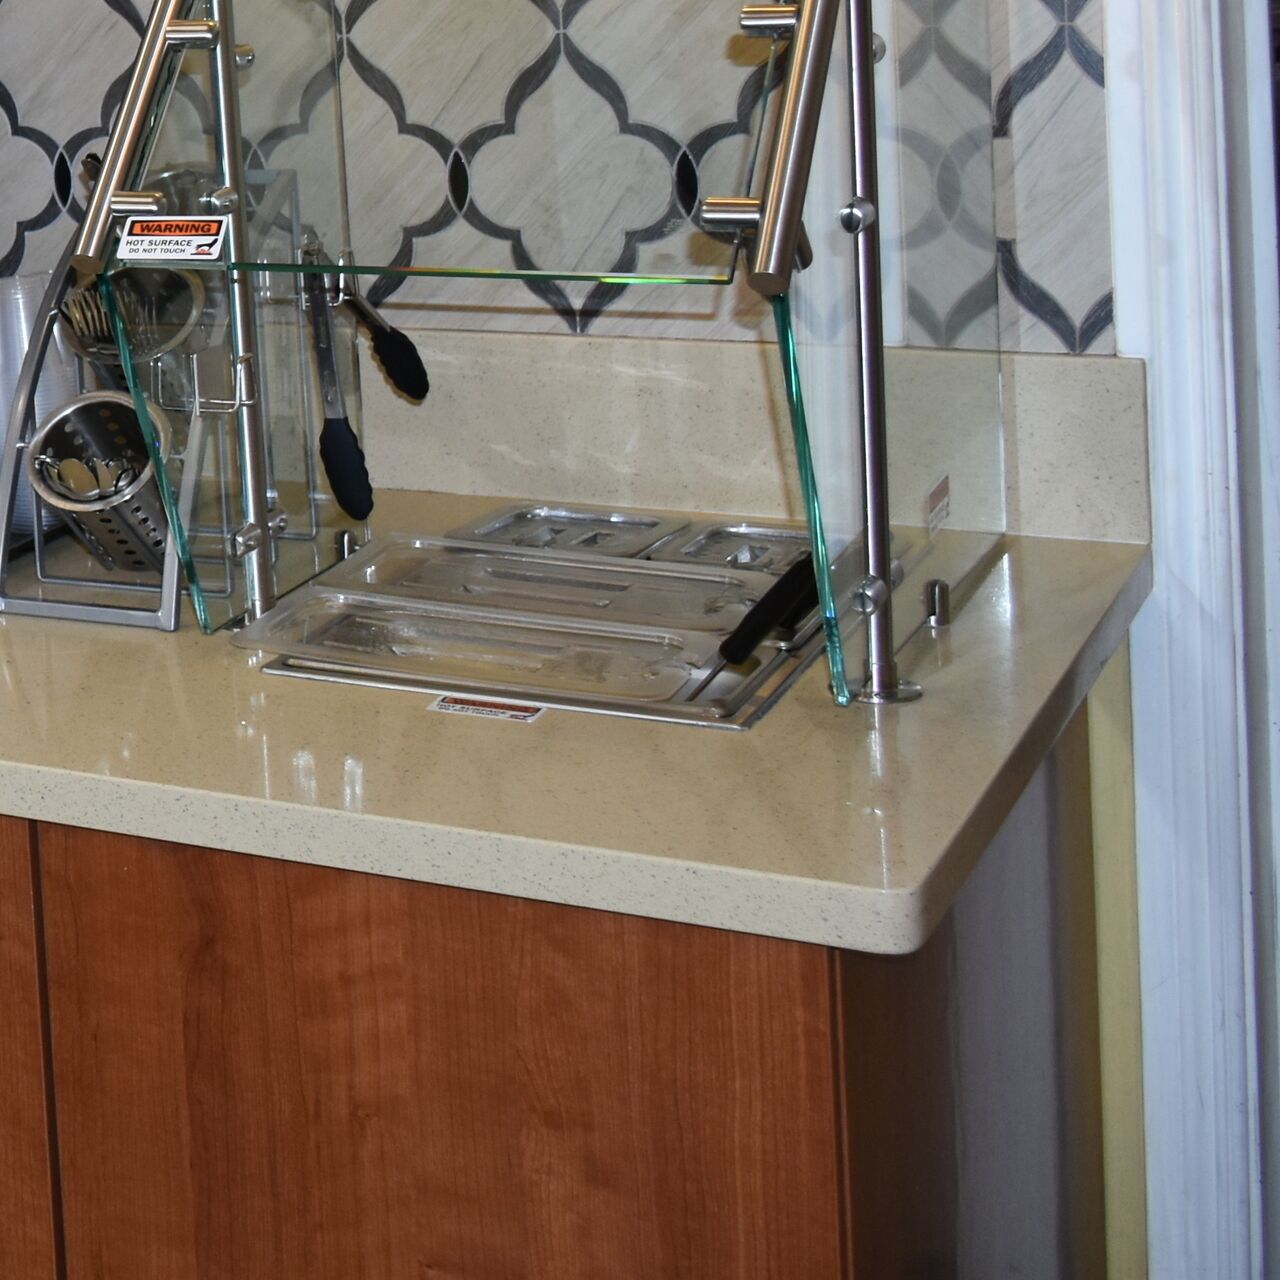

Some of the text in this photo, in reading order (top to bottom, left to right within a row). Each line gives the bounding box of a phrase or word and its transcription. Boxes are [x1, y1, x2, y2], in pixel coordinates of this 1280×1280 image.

[139, 223, 213, 233] WARNING
[125, 239, 194, 247] HOT SURFACE
